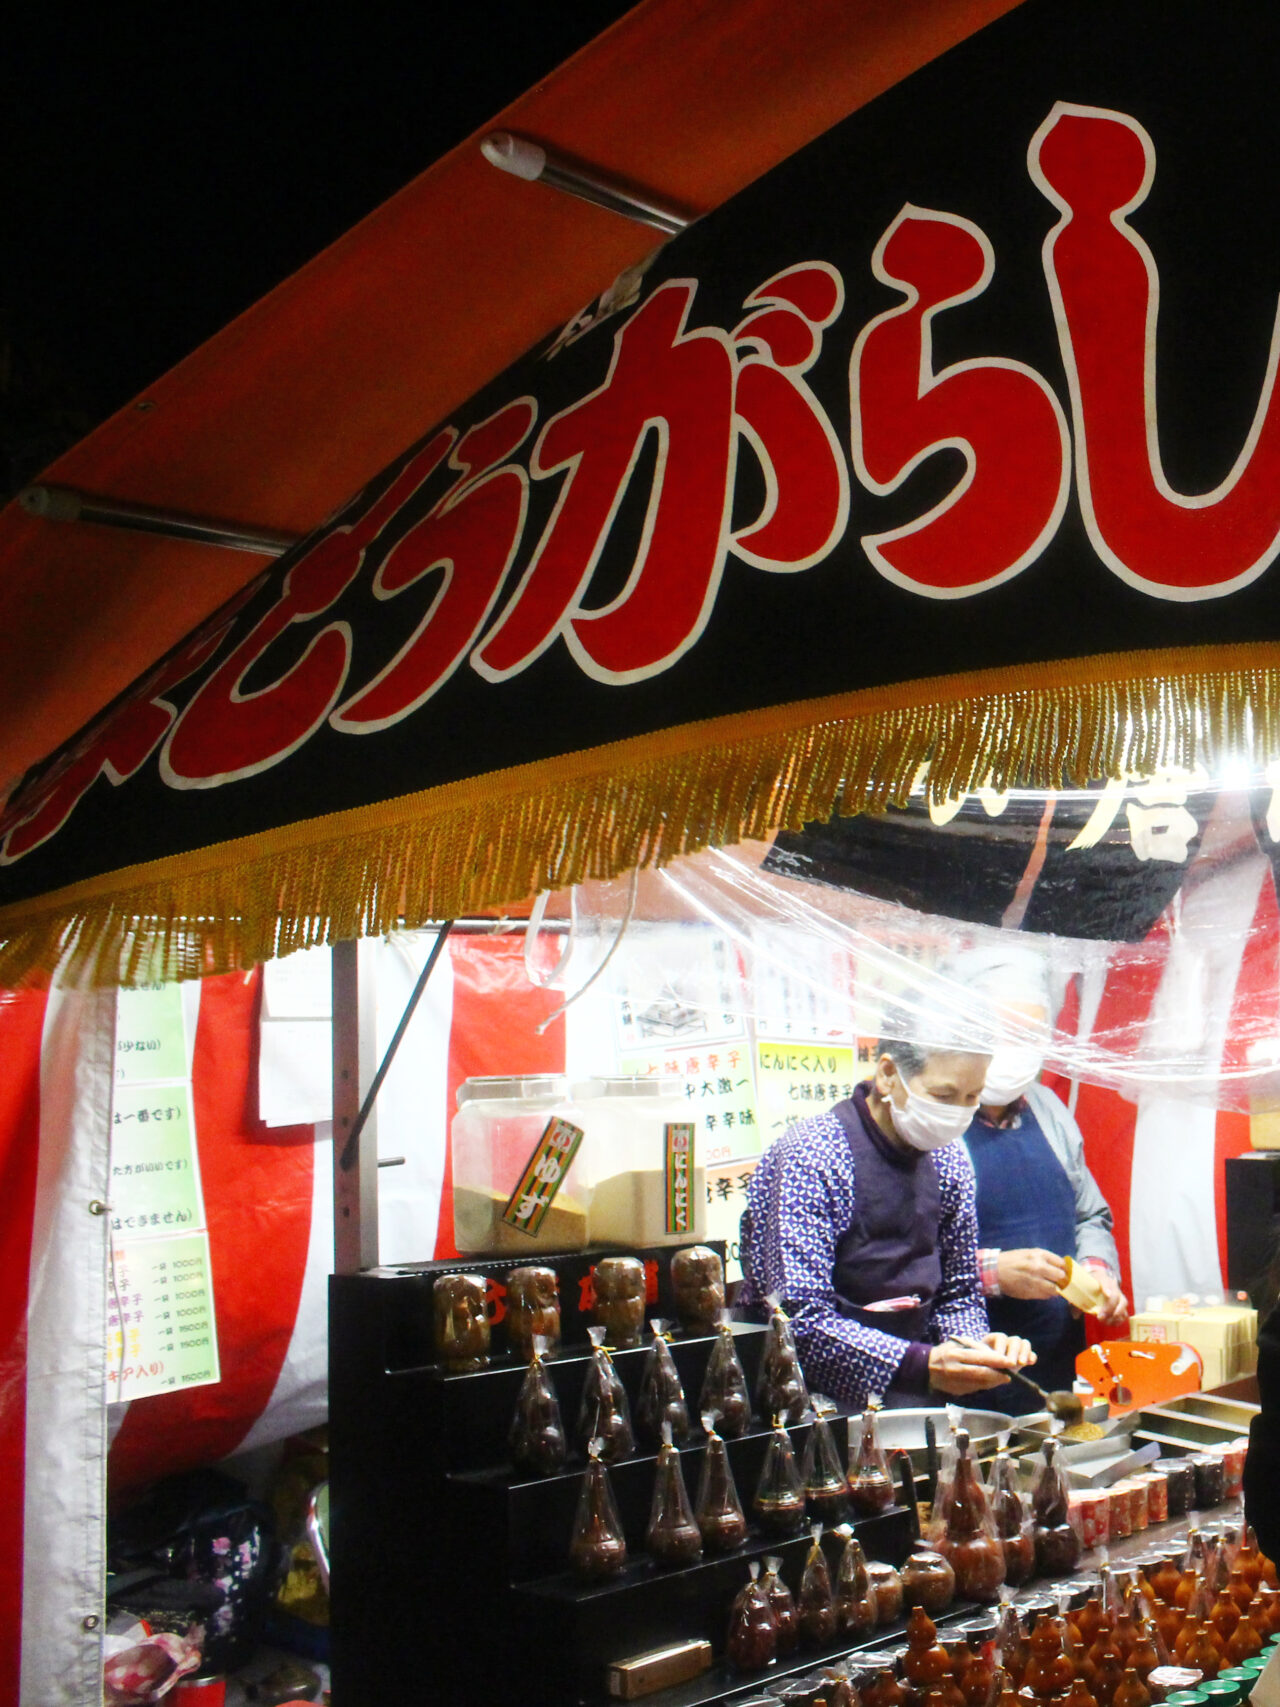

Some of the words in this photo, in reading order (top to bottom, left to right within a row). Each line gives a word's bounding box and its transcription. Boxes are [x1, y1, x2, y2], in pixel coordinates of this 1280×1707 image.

[759, 1052, 838, 1074] にんにく入り
[514, 1154, 561, 1220] ゆず
[674, 1153, 688, 1227] にんにく
